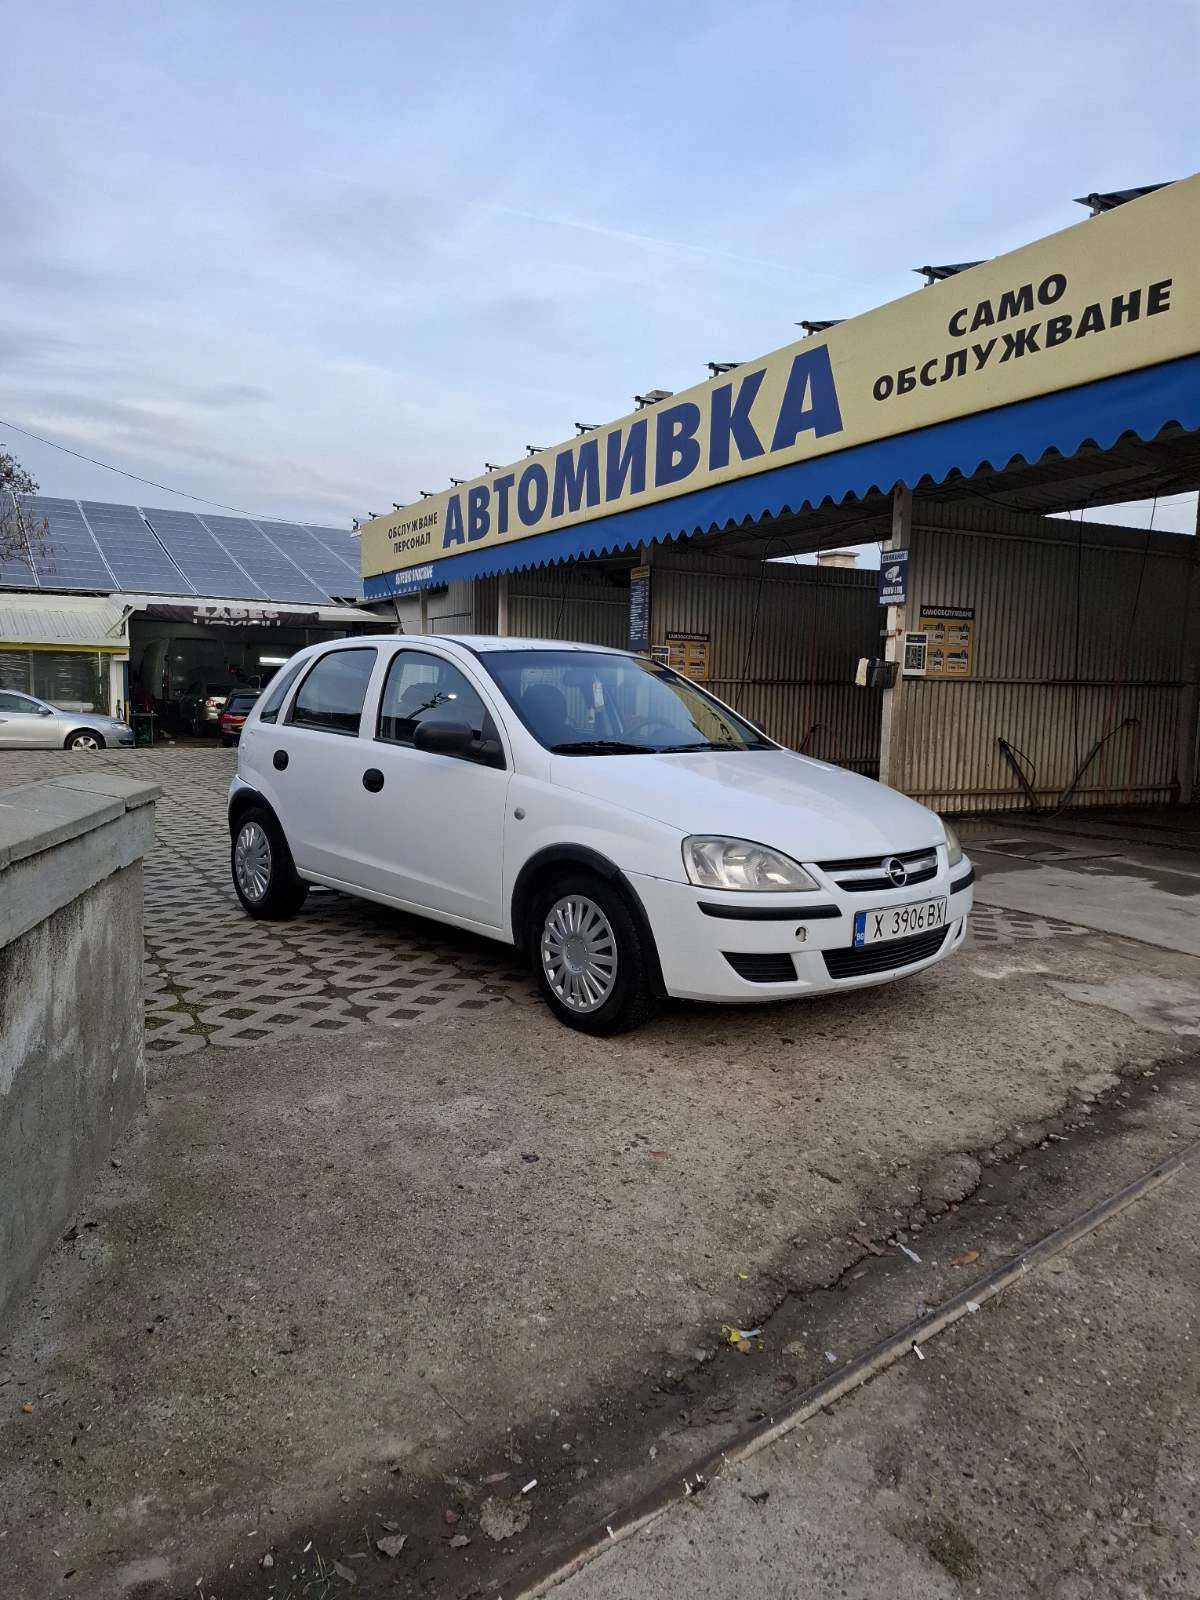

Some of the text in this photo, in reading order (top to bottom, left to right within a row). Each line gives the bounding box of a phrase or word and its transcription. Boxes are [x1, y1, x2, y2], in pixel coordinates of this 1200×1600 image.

[948, 273, 1067, 338] САМО
[873, 278, 1173, 401] ОБСЛУЖВАНЕ
[442, 343, 844, 549] АВТОМИВКА
[388, 511, 438, 540] ОБСЛУЖВАНЕ
[393, 532, 431, 554] ПЕРСОНАЛ
[874, 901, 944, 938] X 3906 BX
